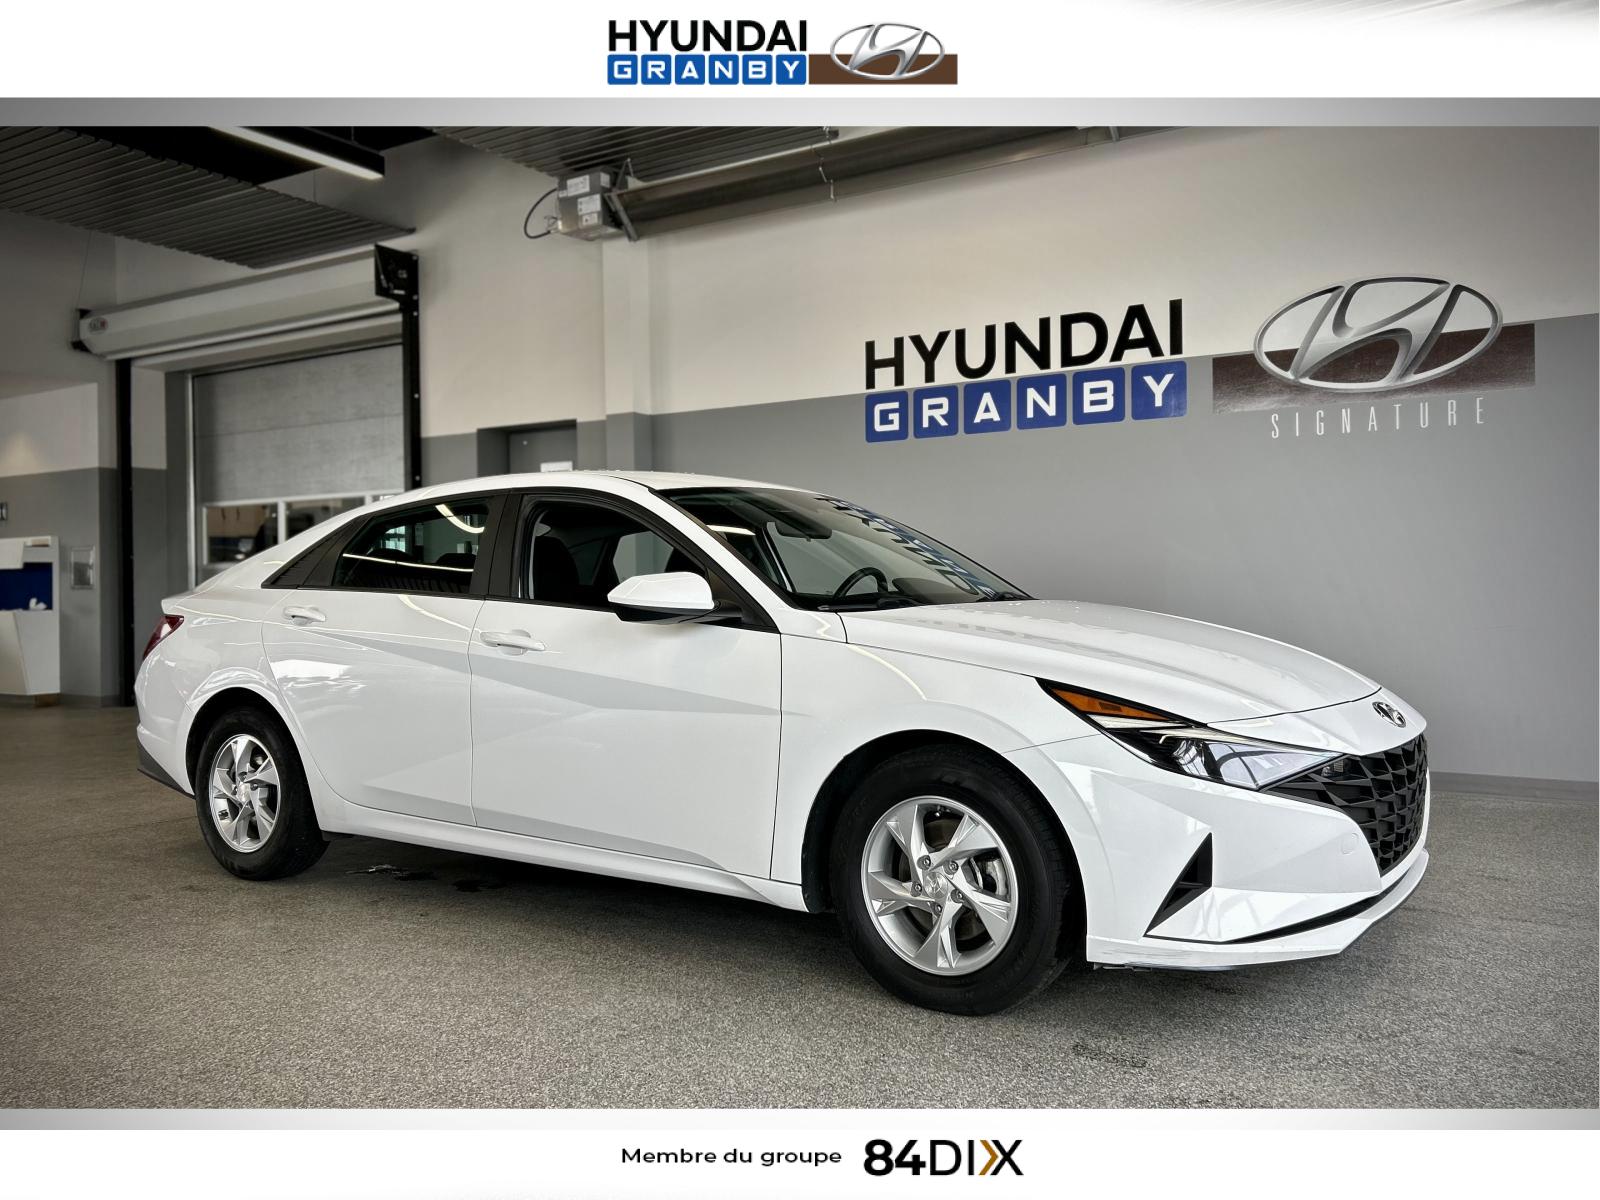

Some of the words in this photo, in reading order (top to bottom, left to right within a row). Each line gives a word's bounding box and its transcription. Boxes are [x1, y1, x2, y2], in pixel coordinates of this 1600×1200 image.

[865, 298, 1183, 390] HYUNDAI
[873, 373, 1180, 433] GRANBY
[1270, 396, 1486, 440] SIGNATURE
